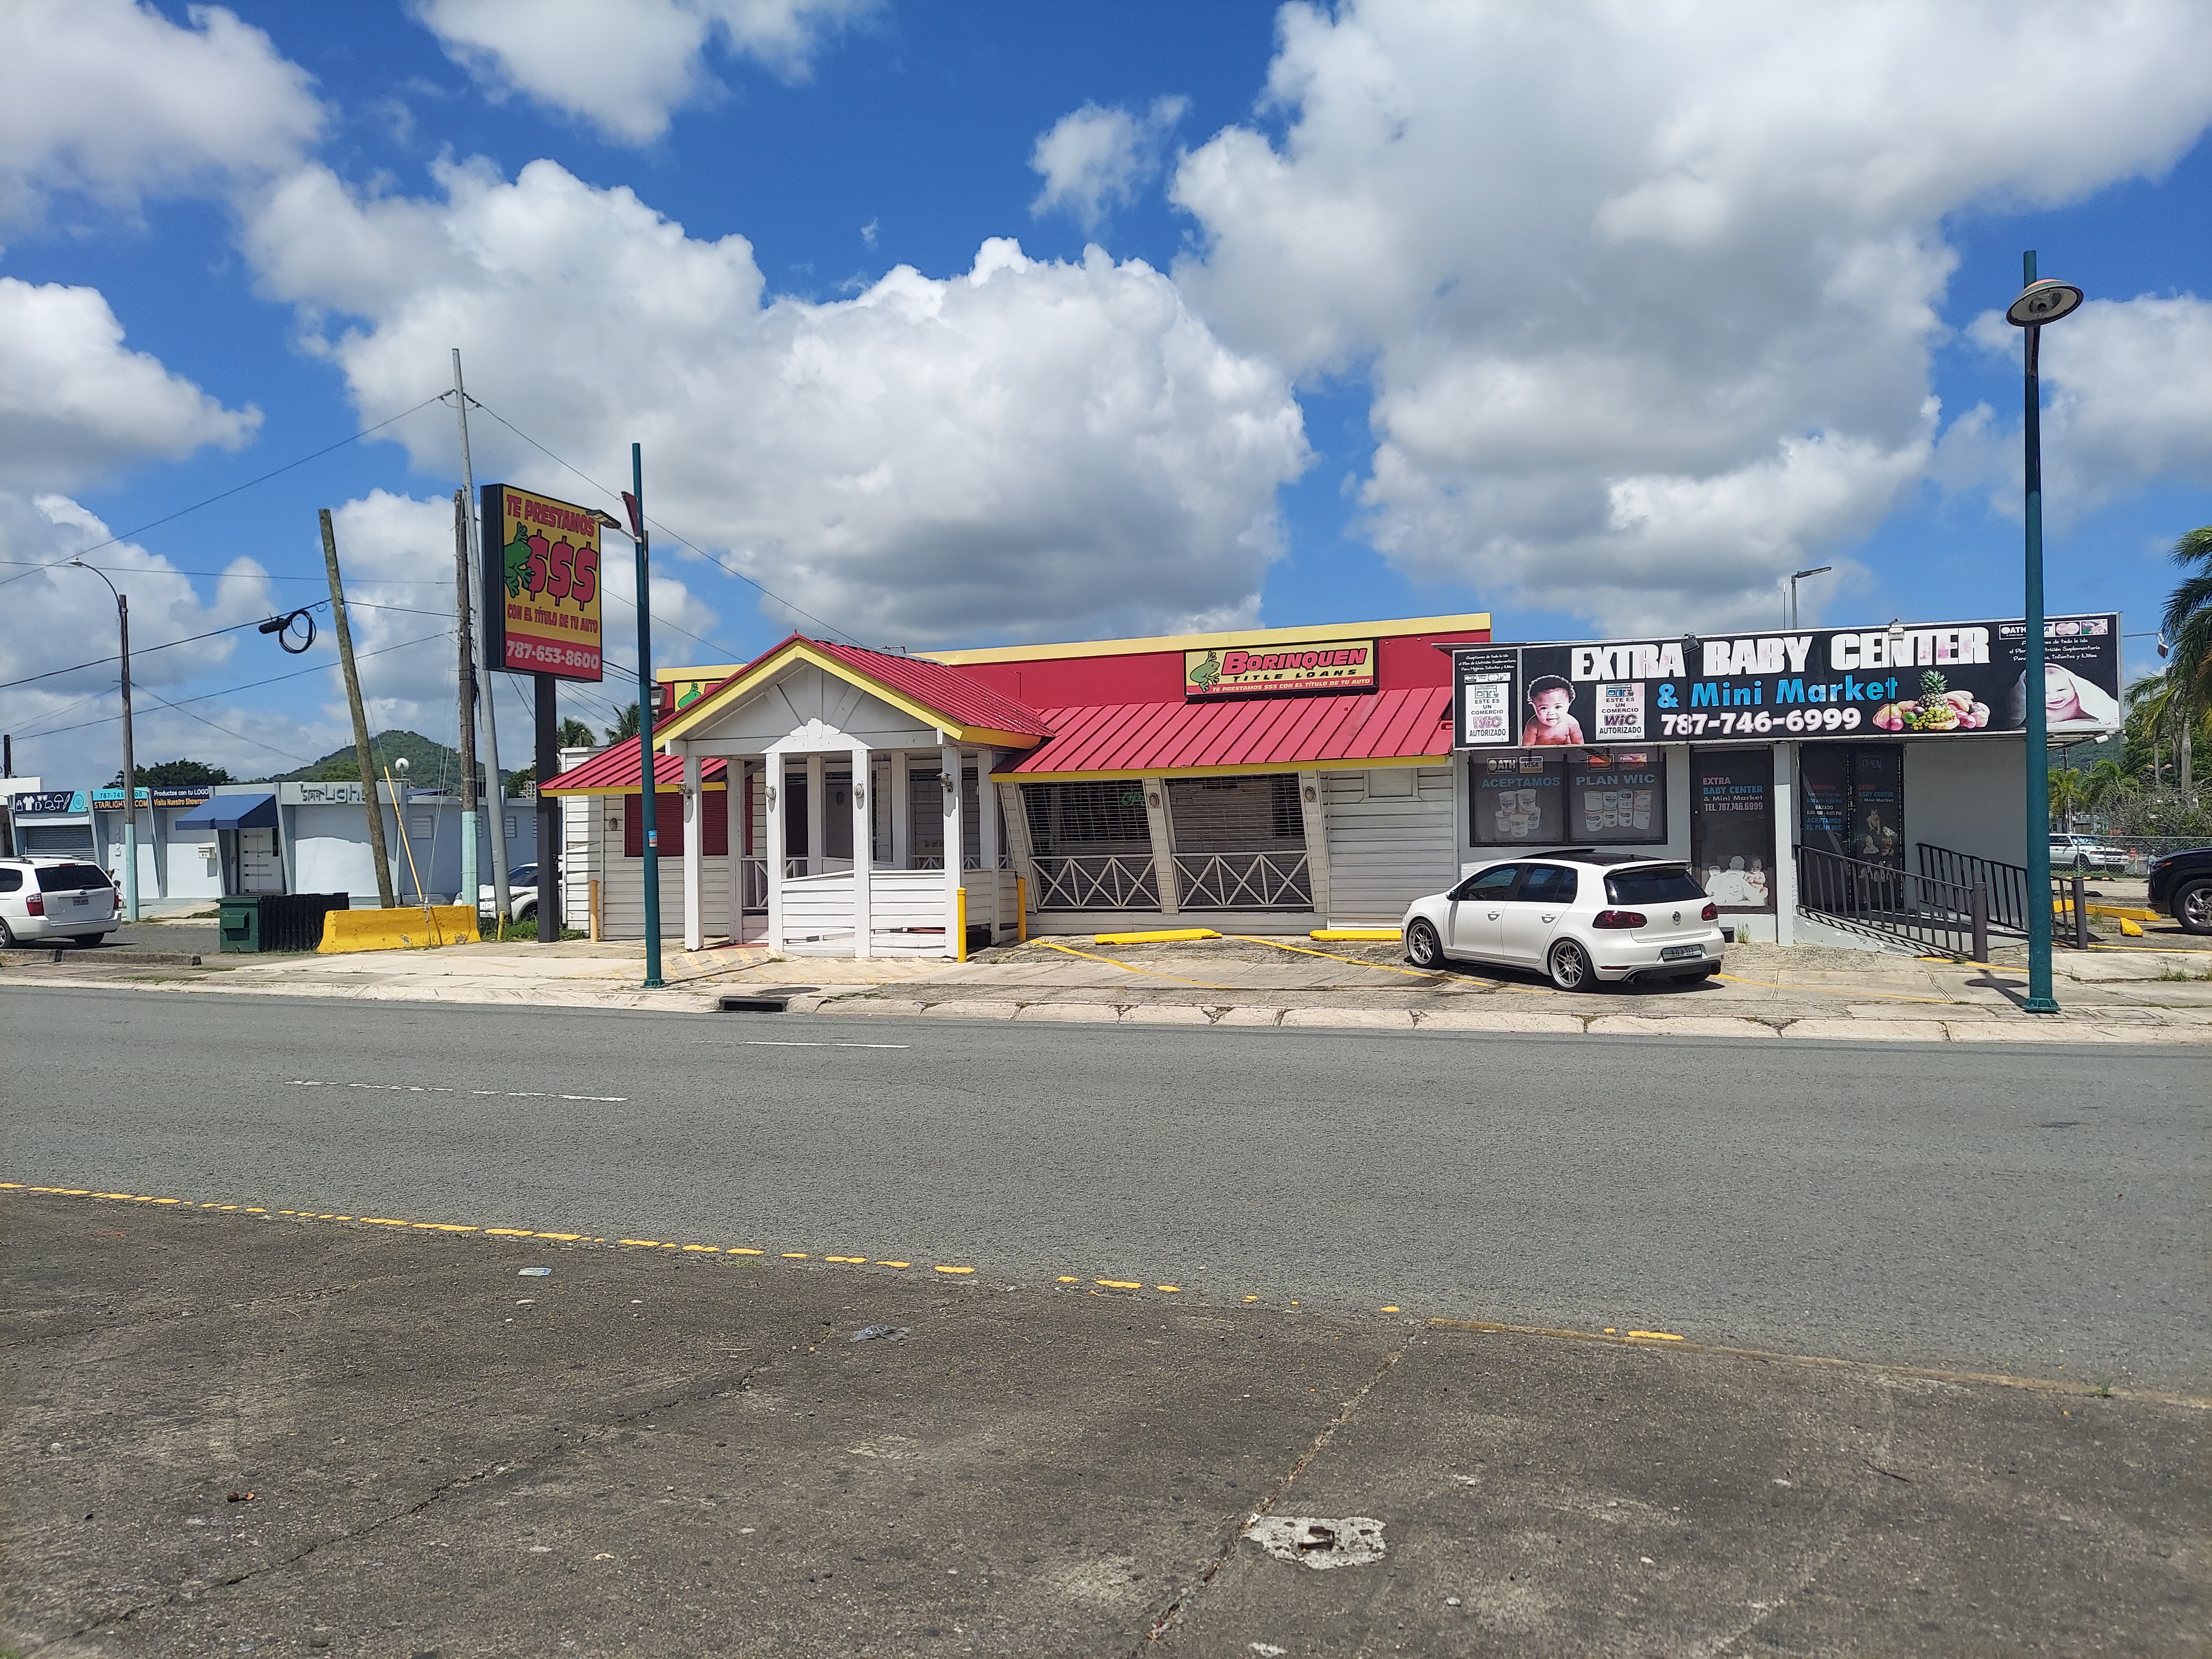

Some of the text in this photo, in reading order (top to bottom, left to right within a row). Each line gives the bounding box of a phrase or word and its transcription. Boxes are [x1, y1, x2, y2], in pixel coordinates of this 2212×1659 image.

[507, 494, 595, 537] TE PRESTAMOS
[527, 529, 598, 611] $$$
[508, 604, 598, 633] CON EL TÍTULO DE TU AUTO
[507, 640, 599, 670] 787-653-8600
[1221, 647, 1368, 676] BORINQUEN
[1571, 627, 1991, 682] EXTRA BABY CENTER
[1233, 669, 1357, 683] TITLE LOANS
[1657, 675, 1898, 708] & Mini Market
[1661, 708, 1861, 736] 787-746-6999
[1469, 729, 1506, 737] AUTORIZADO
[1497, 759, 1516, 769] ATH
[1482, 777, 1561, 788] ACEPTAMOS
[1576, 774, 1655, 785] PLAN WIC
[1703, 785, 1763, 795] BABY CENTER
[154, 798, 166, 806] Visita
[1704, 802, 1763, 811] TEL. 787.746.6999
